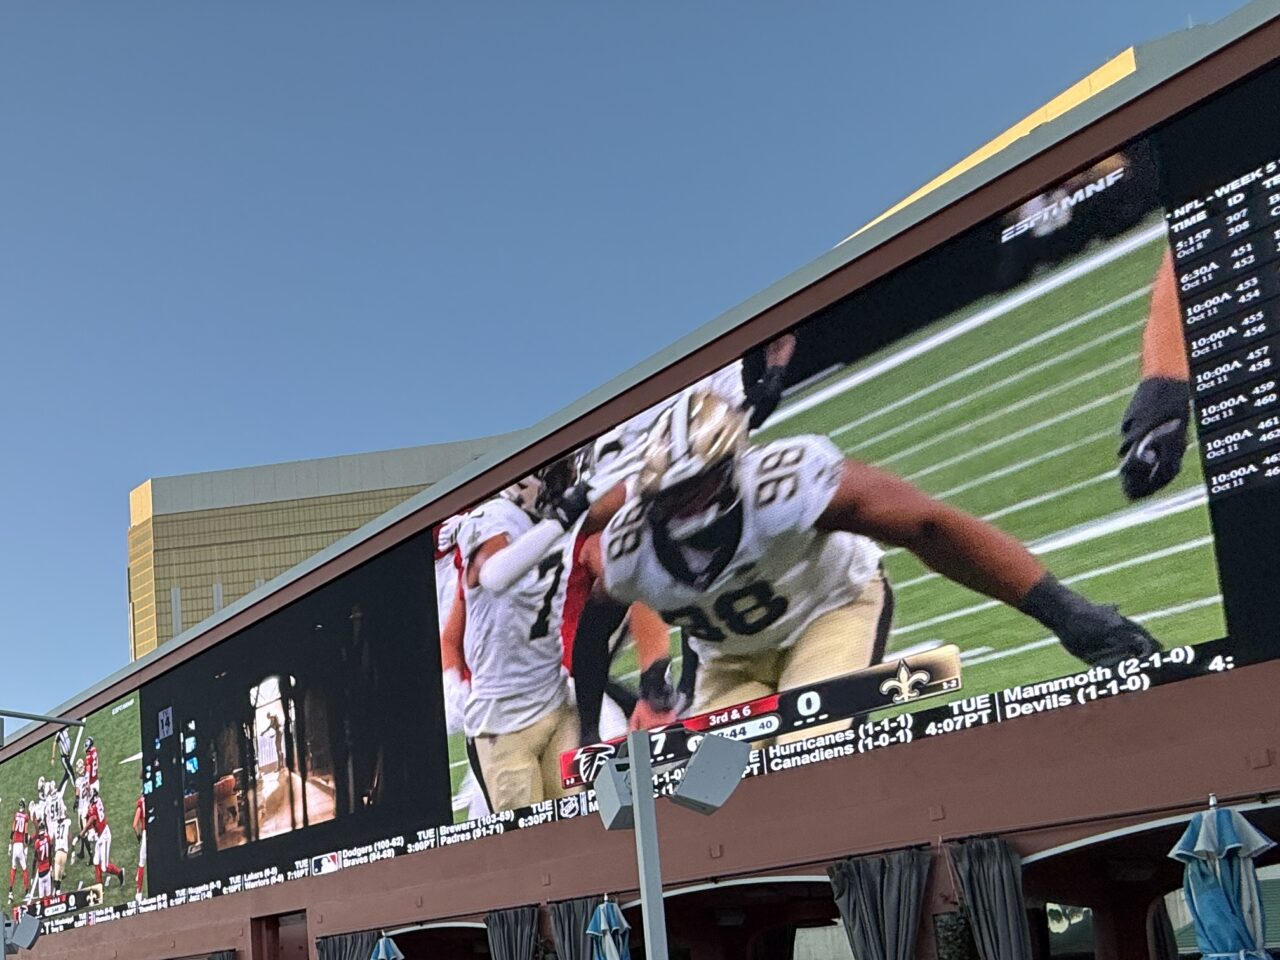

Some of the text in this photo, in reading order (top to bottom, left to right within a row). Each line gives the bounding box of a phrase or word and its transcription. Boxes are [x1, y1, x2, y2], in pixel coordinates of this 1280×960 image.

[1174, 200, 1205, 218] NFL
[1214, 168, 1263, 198] WEEK
[1265, 161, 1277, 174] 5
[1170, 210, 1207, 233] TIME
[1227, 193, 1245, 207] ID
[1176, 228, 1211, 250] 5:15P
[1225, 208, 1248, 225] 307
[1177, 246, 1195, 258] Oct
[1227, 220, 1250, 237] 308
[1180, 243, 1253, 284] 6:30A 451
[1181, 255, 1255, 291] Oct 11 452
[1186, 277, 1258, 317] 10:00A 453
[1186, 289, 1260, 324] Oct 11 454
[1191, 310, 1264, 350] 10:00A 455
[1191, 323, 1266, 358] Oct 11 456
[1196, 345, 1269, 383] 10:00A 457
[1196, 358, 1271, 391] Oct 11 458
[1201, 381, 1275, 417] 10:00A 459
[1201, 393, 1277, 425] Oct 11 460
[1206, 416, 1279, 451] 10:00A 461
[1206, 428, 1280, 459] Oct 11 462
[1211, 464, 1259, 485] 10:00A
[1211, 466, 1280, 493] Oct 11 46
[1004, 666, 1111, 703] Mammoth
[1117, 645, 1195, 679] (2-1-0)
[948, 694, 991, 716] TUE
[1005, 673, 1150, 719] Devils (1-1-0)
[161, 716, 170, 731] 14
[650, 732, 667, 755] 7
[759, 720, 773, 730] 40
[796, 690, 821, 716] 0
[709, 705, 751, 726] 3rd & 6
[925, 710, 992, 737] 4:07PT
[769, 728, 855, 759] Hurricanes
[858, 712, 913, 738] (1-1-1)
[770, 742, 854, 772] Canadiens
[858, 728, 913, 754] (1-0-1)
[518, 812, 554, 829] 6:30PT
[531, 799, 553, 814] TUE
[417, 827, 436, 841] TUE
[439, 821, 476, 836] Brewers
[440, 830, 471, 846] Padres
[342, 844, 373, 859] Dodgers
[343, 855, 369, 868] Braves
[407, 839, 436, 854] 3:00PT
[229, 874, 241, 885] TUE
[294, 859, 309, 870] TUE
[244, 878, 270, 890] Warriors
